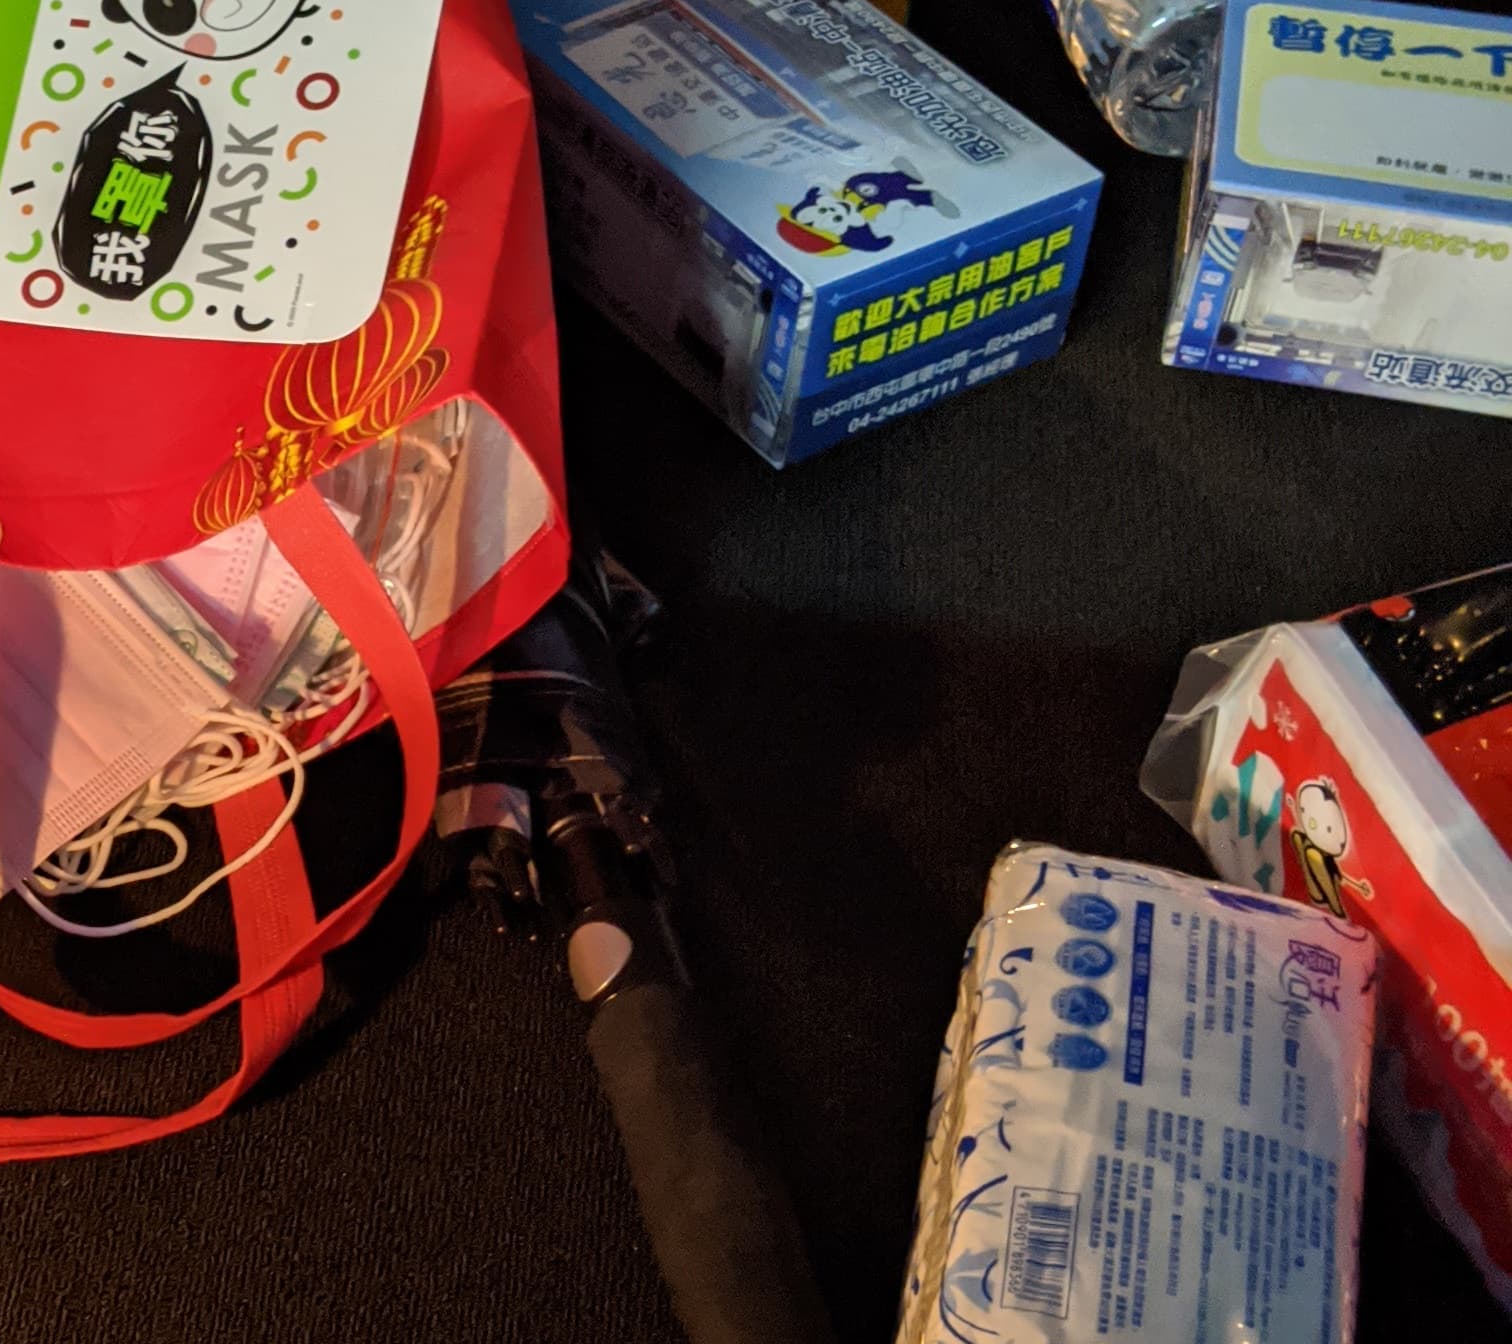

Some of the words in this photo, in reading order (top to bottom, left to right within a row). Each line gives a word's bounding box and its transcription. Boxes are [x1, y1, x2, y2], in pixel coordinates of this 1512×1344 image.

[89, 105, 180, 287] 我罩你
[195, 122, 282, 294] MASK
[825, 264, 1067, 380] 來電洽詢合作方案
[831, 226, 1075, 343] 歡迎大宗用油客戶
